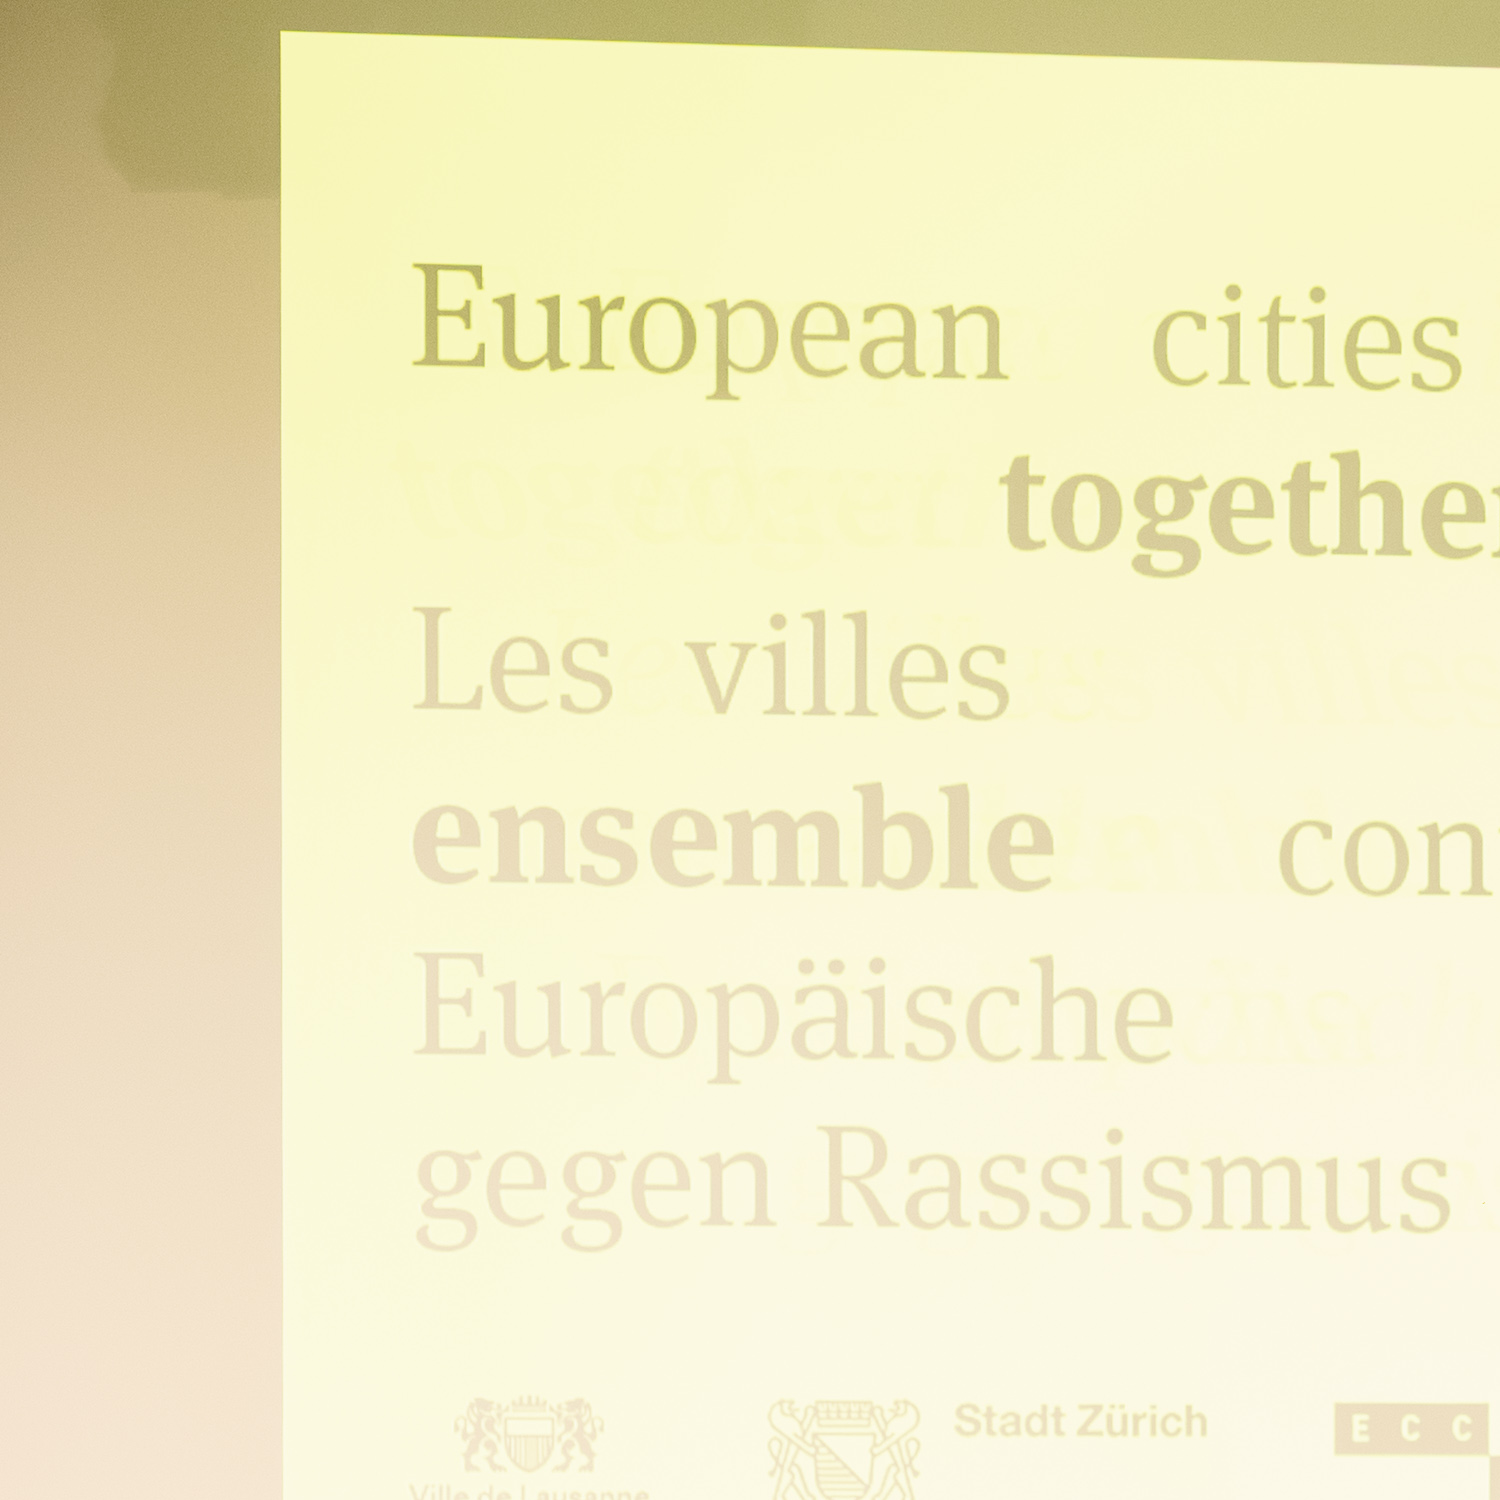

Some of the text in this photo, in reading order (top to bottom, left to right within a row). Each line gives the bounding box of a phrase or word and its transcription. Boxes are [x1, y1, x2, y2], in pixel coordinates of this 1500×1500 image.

[413, 263, 1009, 400] European
[1153, 284, 1462, 392] cities
[413, 607, 613, 714] Les
[685, 609, 1009, 721] villes
[414, 782, 1054, 892] ensemble
[416, 953, 1173, 1084] Europäische
[417, 1126, 1450, 1253] gegen Rassismus
[955, 1403, 1207, 1437] Stadt Zürich
